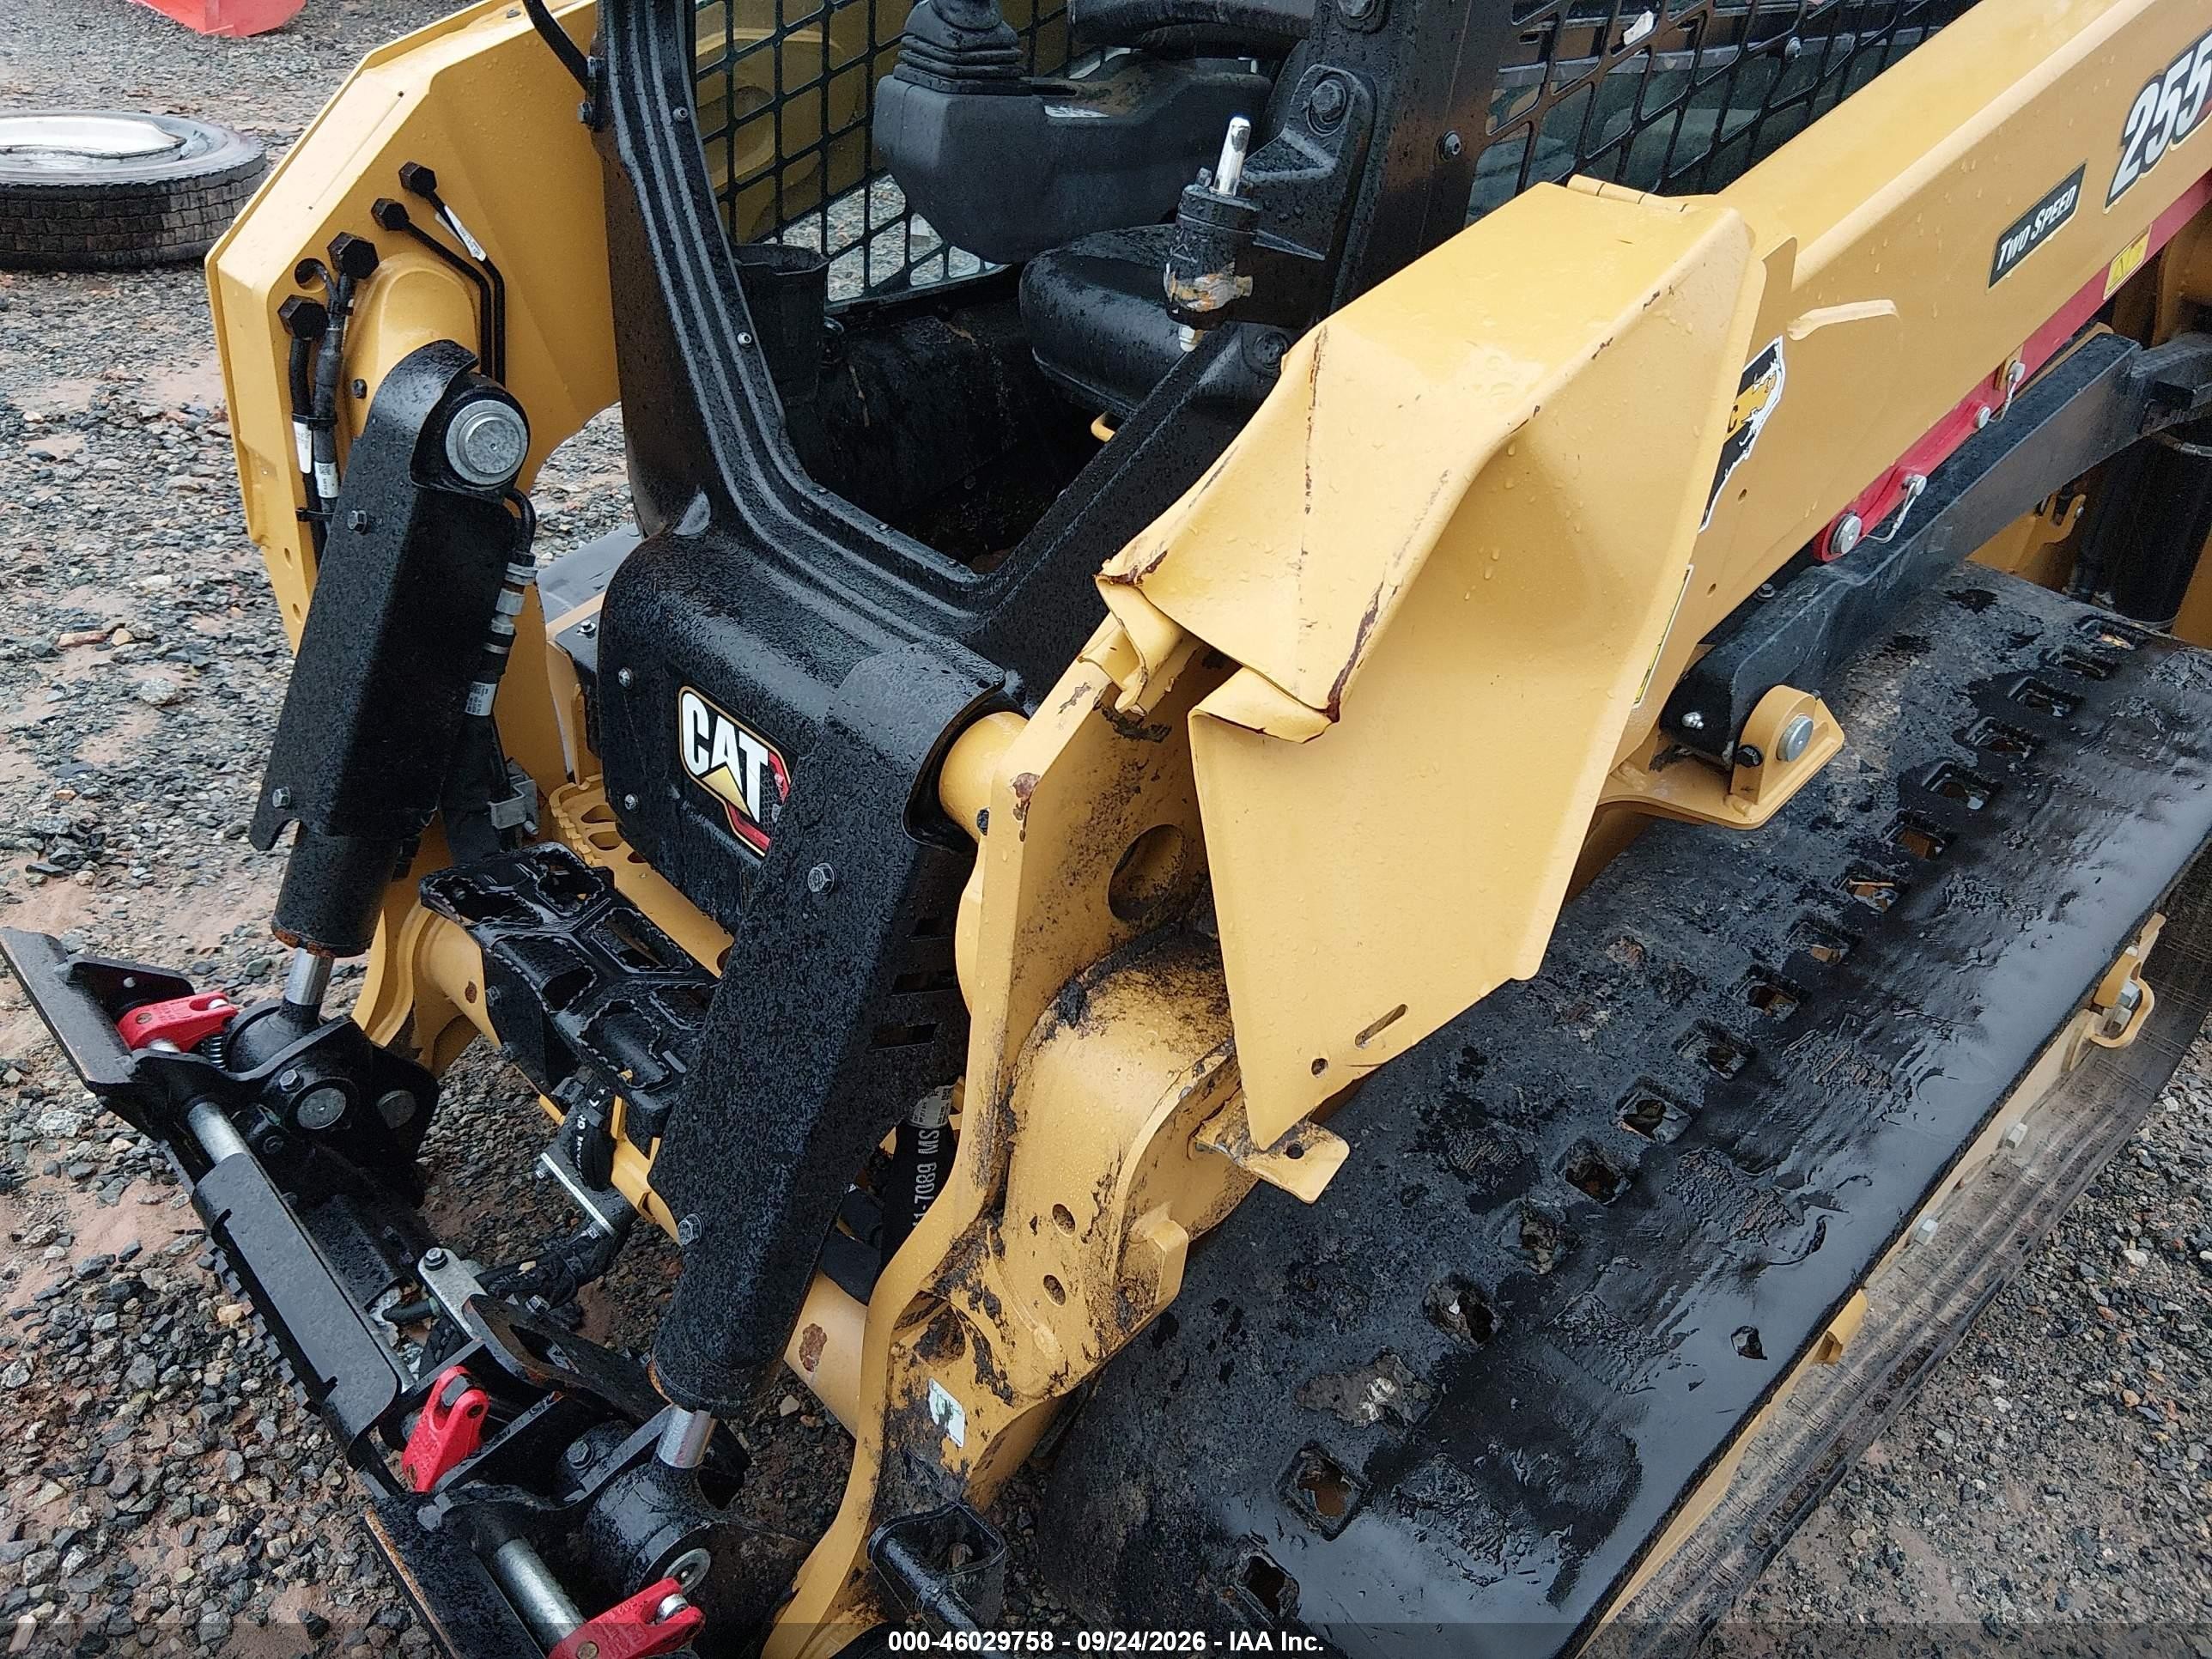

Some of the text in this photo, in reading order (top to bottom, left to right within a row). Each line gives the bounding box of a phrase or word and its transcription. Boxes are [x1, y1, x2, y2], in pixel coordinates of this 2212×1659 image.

[2109, 33, 2212, 198] 255
[682, 693, 769, 823] CAT
[912, 1162, 938, 1226] 1-7089
